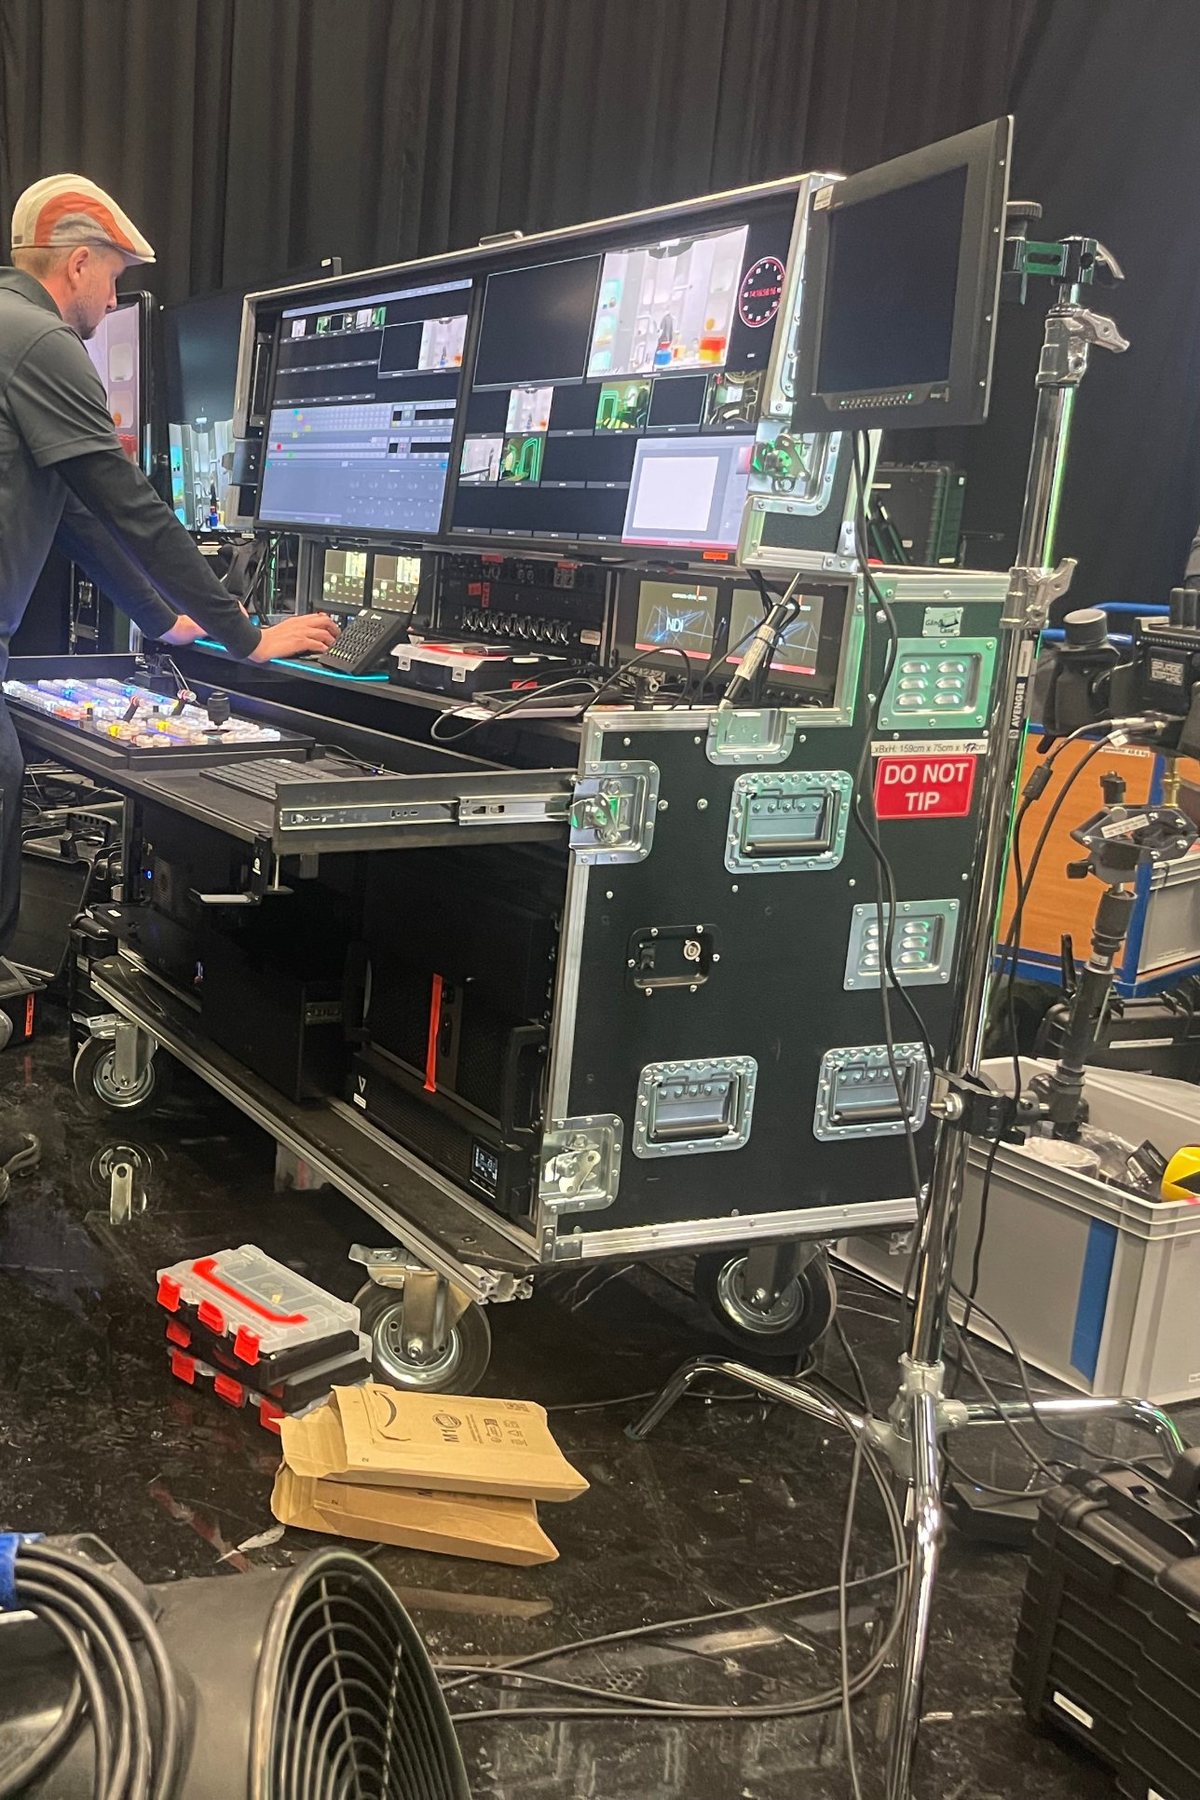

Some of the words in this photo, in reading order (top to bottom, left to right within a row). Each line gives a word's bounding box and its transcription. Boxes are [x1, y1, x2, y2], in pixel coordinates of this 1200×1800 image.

[666, 617, 684, 633] NDI
[1011, 682, 1026, 727] AVENGER
[884, 764, 917, 785] DO
[922, 762, 969, 783] NOT
[905, 791, 940, 811] TIP
